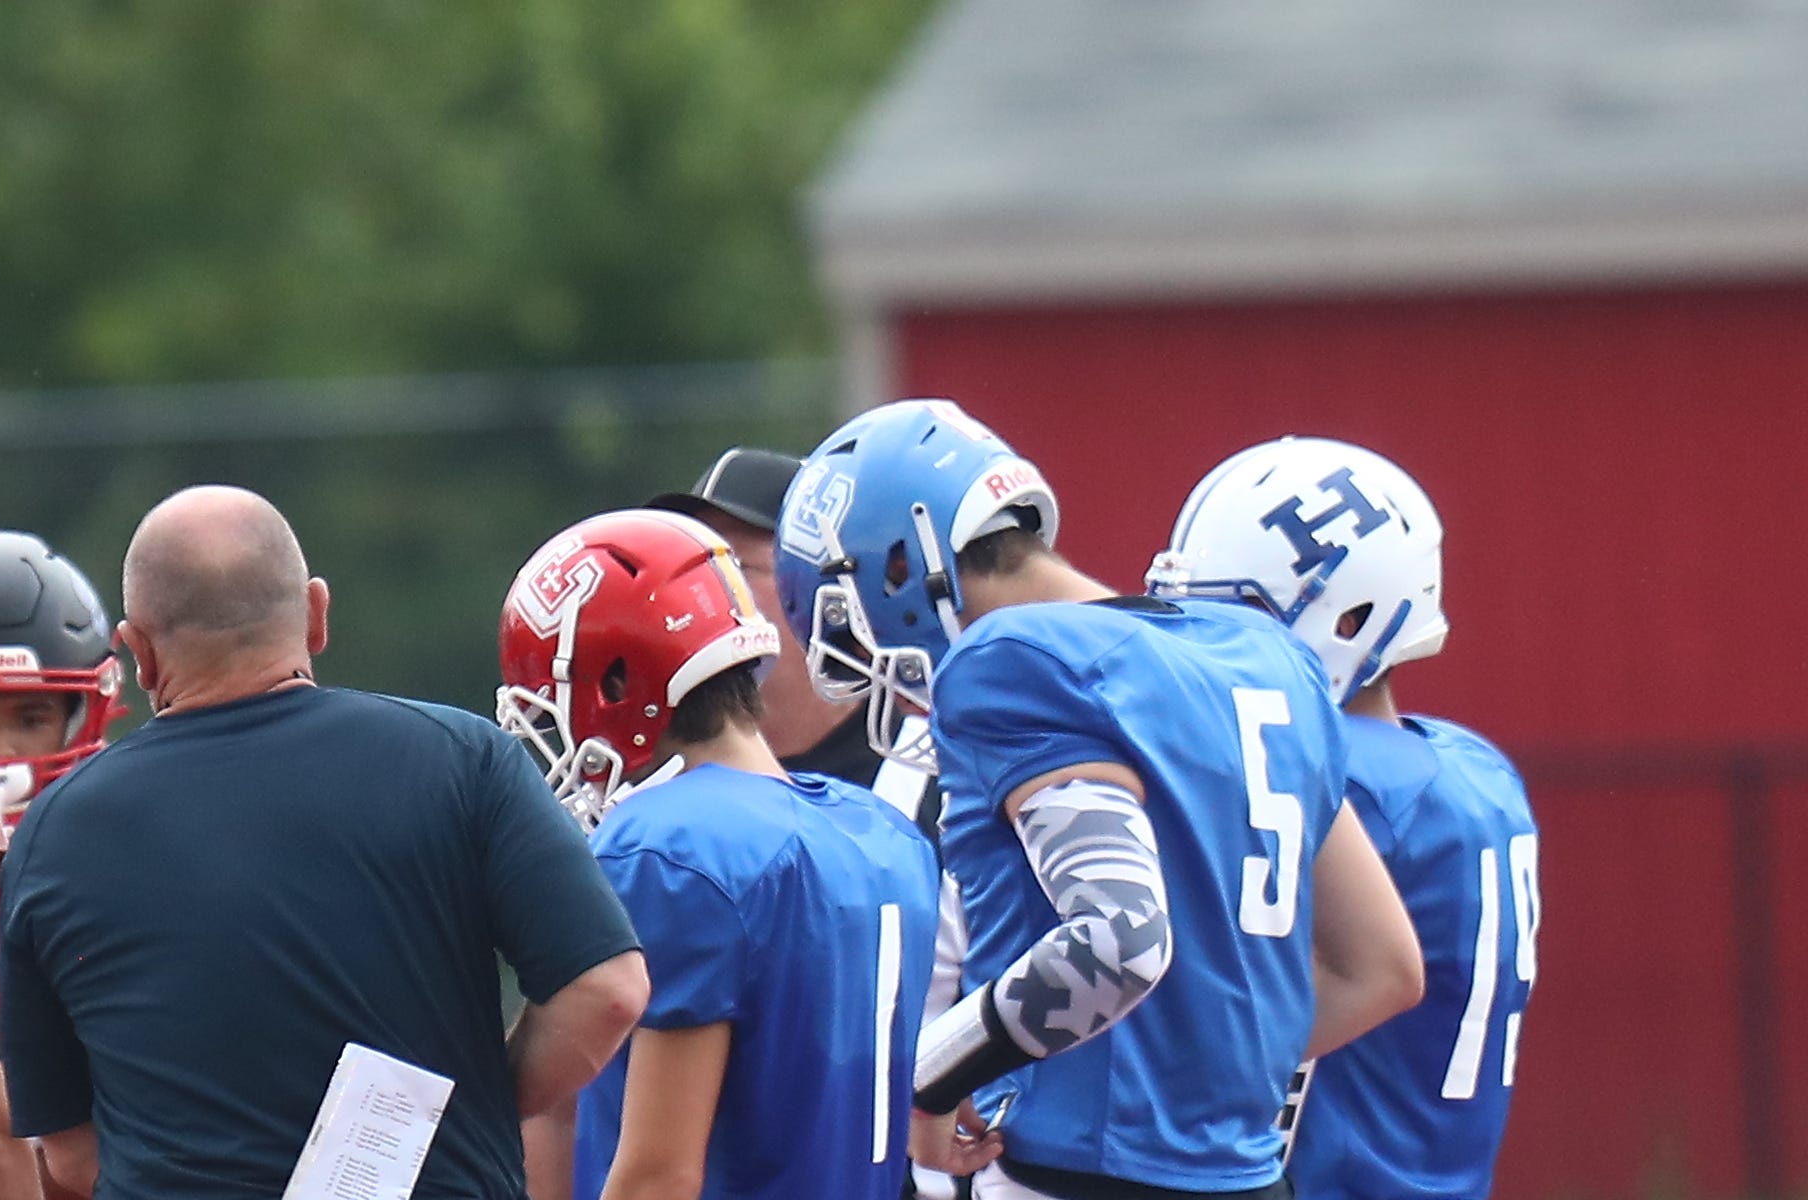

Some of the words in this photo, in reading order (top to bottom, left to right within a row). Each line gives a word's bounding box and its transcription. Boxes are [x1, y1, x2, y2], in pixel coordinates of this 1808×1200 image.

[1259, 466, 1391, 577] H
[1232, 687, 1304, 938] 5
[871, 903, 903, 1164] 1
